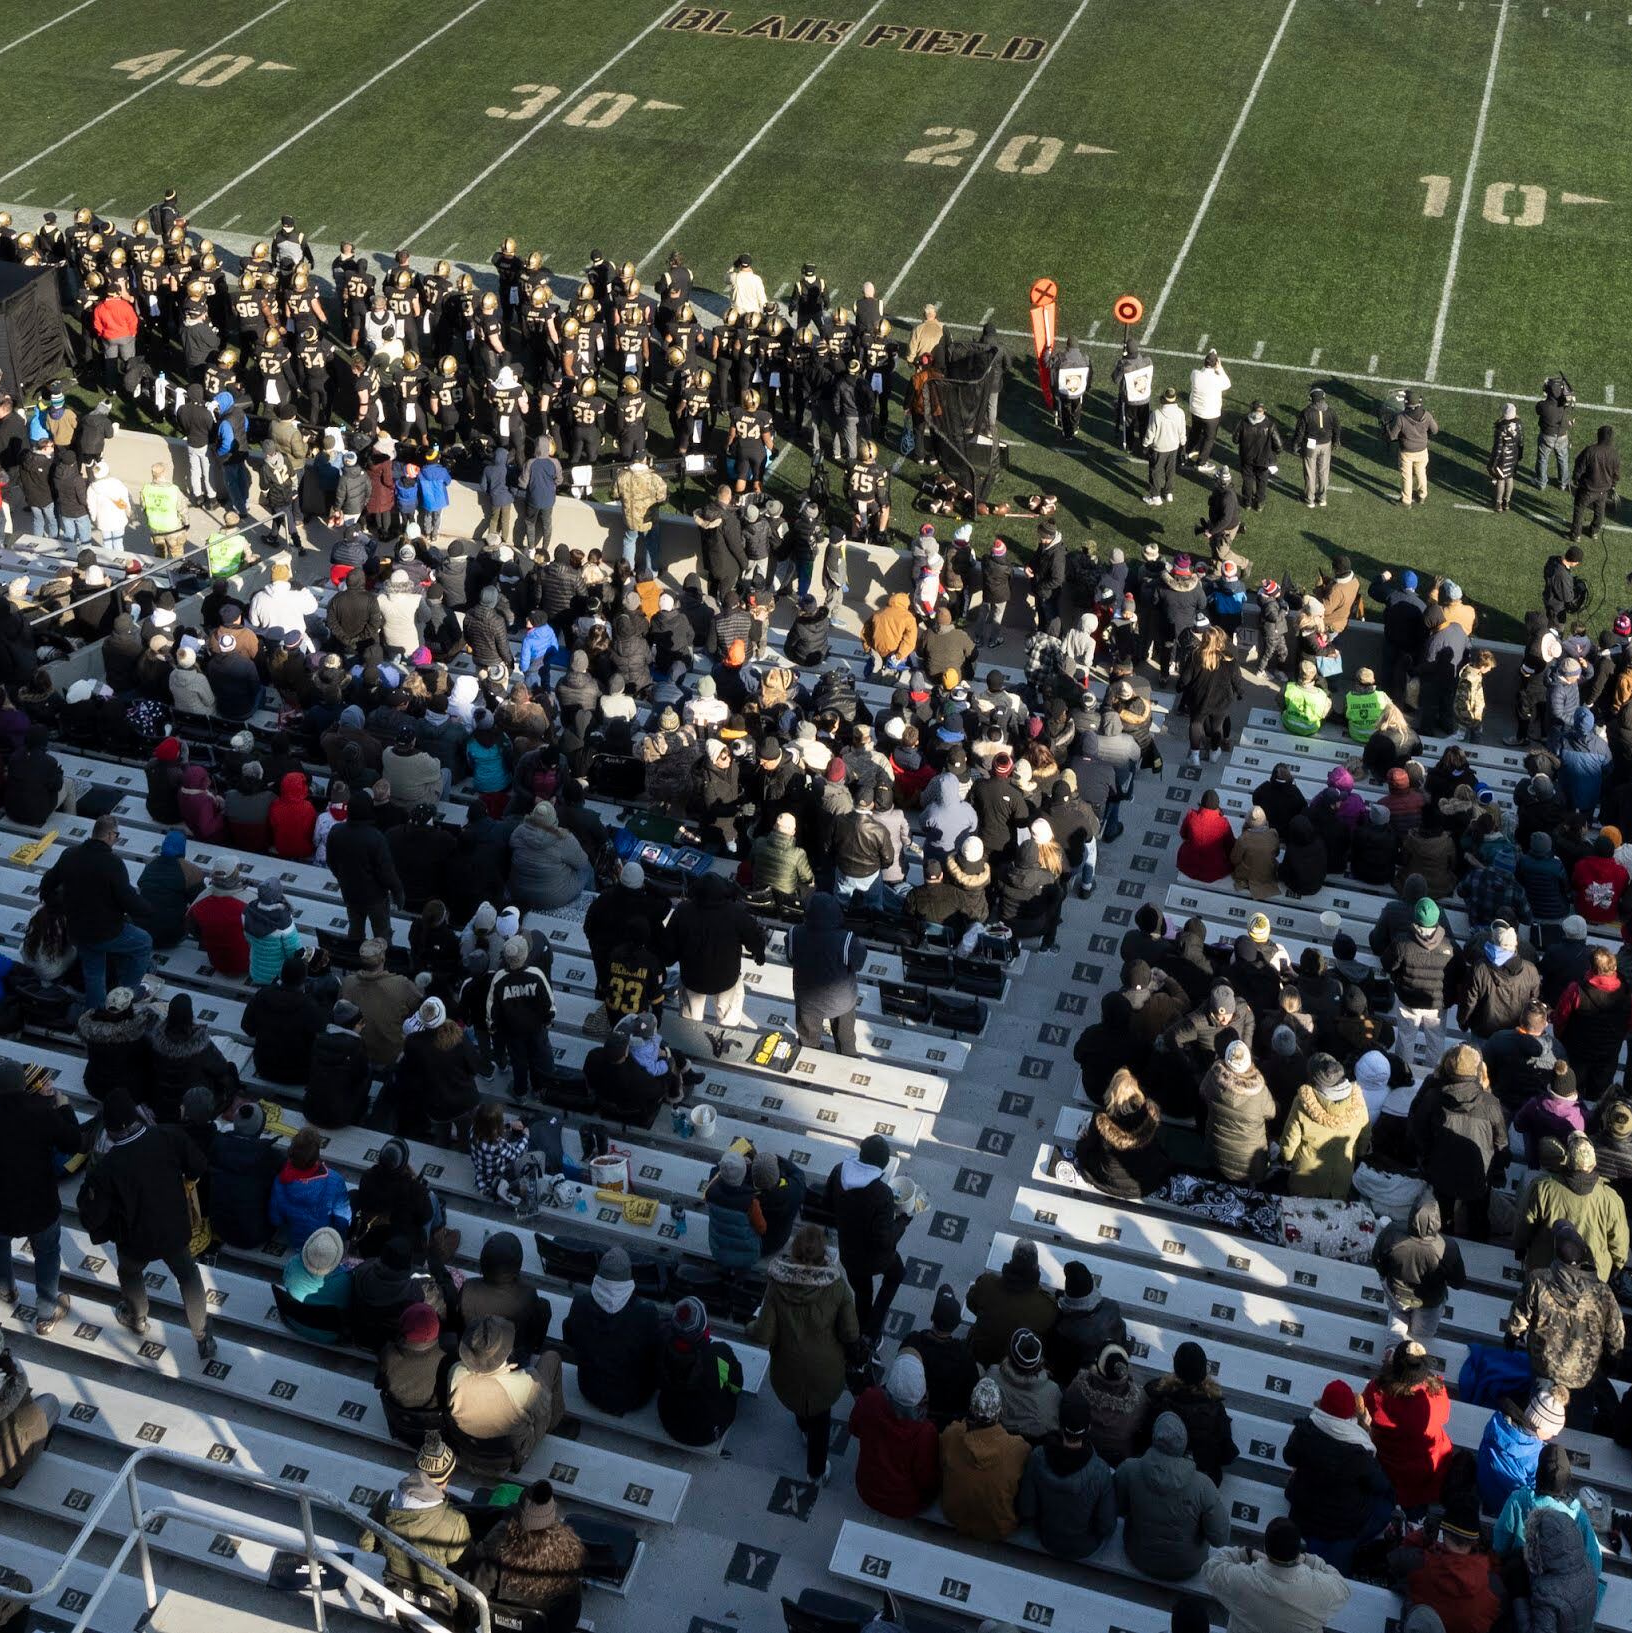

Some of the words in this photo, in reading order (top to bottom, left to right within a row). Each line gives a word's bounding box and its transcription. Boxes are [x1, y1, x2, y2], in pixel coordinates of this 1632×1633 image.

[662, 6, 856, 44] BLAIK
[863, 23, 1051, 63] FIELD
[111, 48, 256, 88] 40
[485, 83, 638, 129] 30
[903, 125, 1065, 175] 20
[1420, 174, 1547, 226] 10
[348, 281, 367, 298] 20
[236, 300, 259, 318] 96
[389, 298, 411, 316] 90
[681, 335, 688, 350] 1
[259, 358, 281, 375] 42
[301, 352, 325, 368] 34
[400, 381, 419, 396] 14
[439, 386, 464, 406] 99
[494, 399, 515, 413] 37
[625, 403, 646, 423] 34
[573, 407, 595, 424] 28
[736, 420, 761, 440] 94
[854, 464, 869, 473] ARMY
[850, 474, 873, 493] 45
[1174, 790, 1187, 800] D
[1162, 811, 1174, 822] E
[1151, 835, 1163, 846] F
[1124, 883, 1138, 895] H
[1111, 910, 1125, 922] J
[1096, 939, 1111, 950] K
[1081, 967, 1091, 978] L
[502, 981, 537, 1002] ARMY
[608, 980, 644, 1015] 33
[1064, 998, 1080, 1009] M
[1047, 1027, 1063, 1042] N
[1030, 1061, 1044, 1076] O
[1010, 1098, 1025, 1112] P
[988, 1133, 1003, 1150] Q
[966, 1173, 982, 1192] R
[941, 1219, 958, 1235] S
[914, 1264, 933, 1283] T
[883, 1318, 903, 1336] U
[783, 1484, 805, 1512] X
[746, 1552, 765, 1580] Y
[866, 1556, 888, 1575] 12
[946, 1580, 966, 1599] 11
[1029, 1604, 1049, 1623] 10
